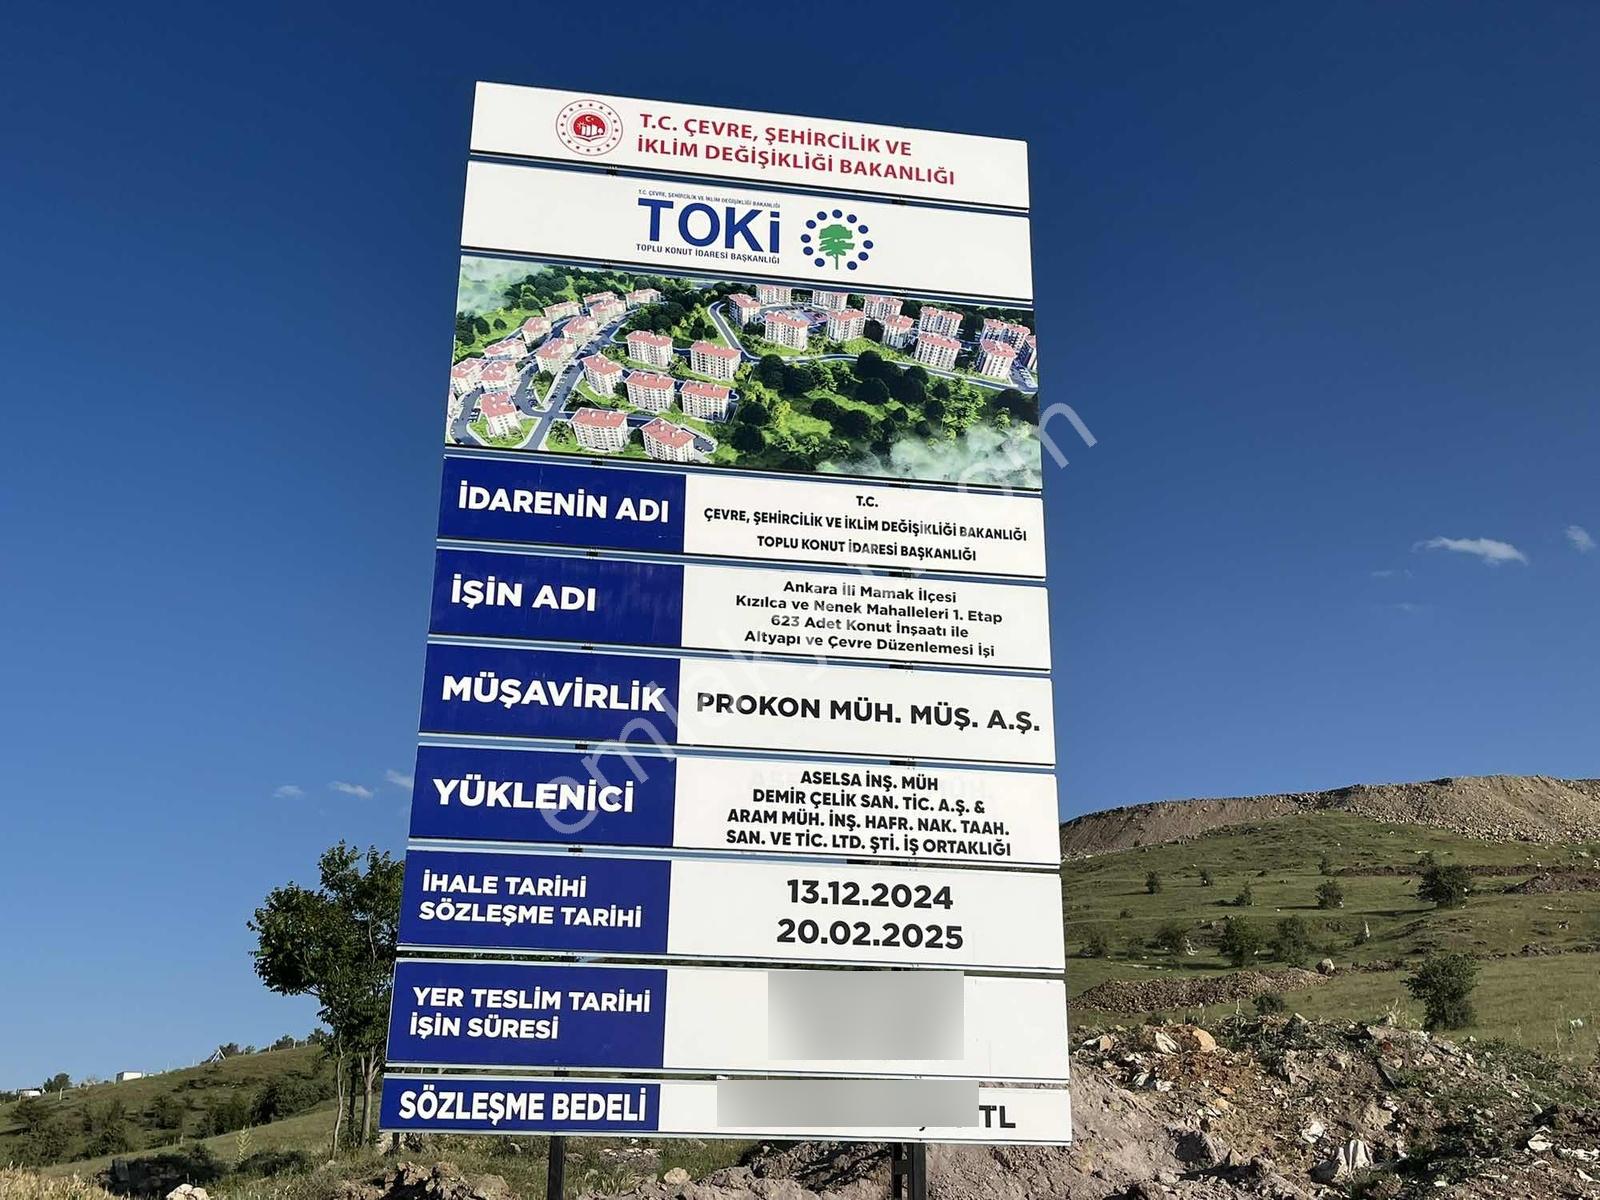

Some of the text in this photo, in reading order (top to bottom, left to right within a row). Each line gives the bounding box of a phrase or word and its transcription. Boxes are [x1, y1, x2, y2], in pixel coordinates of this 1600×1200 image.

[640, 113, 912, 156] T.C. ÇEVRE, ŞEHİRCİLİK VE
[638, 135, 955, 185] İKLİM DEĞİŞİKLİĞİ BAKANLIĞI
[636, 244, 780, 264] TOPLU KONUT İDARESİ BAŞKANLIĞI
[458, 480, 668, 523] İDARENİN ADI
[856, 496, 878, 507] T.C.
[704, 507, 1027, 541] ÇEVRE, ŞEHİRCİLİK VE İKLİM DEĞİŞİKLİĞİ BAKANLIĞI
[757, 535, 976, 561] TOPLU KONUT İDARESİ BAŞKANLIĞI
[451, 574, 596, 611] İŞİN ADI
[783, 580, 956, 604] Ankara İli Mamak İlçesi
[736, 595, 1002, 624] Kızılca ve Nenek Mahalleleri 1. Etap
[771, 614, 969, 639] 623 Adet Konut İnşaatı ile
[745, 630, 995, 659] Altyapı ve Çevre Düzenlemesi İşi
[442, 672, 666, 712] MÜŞAVİRLİK
[697, 692, 1040, 734] PROKON MÜH. MÜŞ. A.Ş.
[433, 774, 634, 813] YÜKLENİCİ
[801, 771, 861, 786] ASELSA
[866, 770, 897, 792] İNŞ.
[902, 774, 938, 791] MÜH
[753, 786, 985, 816] DEMİR ÇELİK SAN. TİC. A.Ş. &
[728, 809, 1009, 835] ARAM MÜH. İNŞ. HAFR. NAK. TAAH.
[726, 829, 1011, 856] SAN. VE TİC. LTD. ŞTİ. İŞ ORTAKLIĞI
[422, 870, 586, 898] İHALE TARİHİ
[787, 879, 953, 909] 13.12.2024
[419, 898, 642, 928] SÖZLEŞME TARİHİ
[777, 919, 963, 949] 20.02.2025
[413, 986, 650, 1013] YER TESLİM TARİHİ
[410, 1012, 558, 1039] İŞİN SÜRESİ
[399, 1084, 646, 1126] SÖZLEŞME BEDELİ
[979, 1105, 1016, 1128] TL
